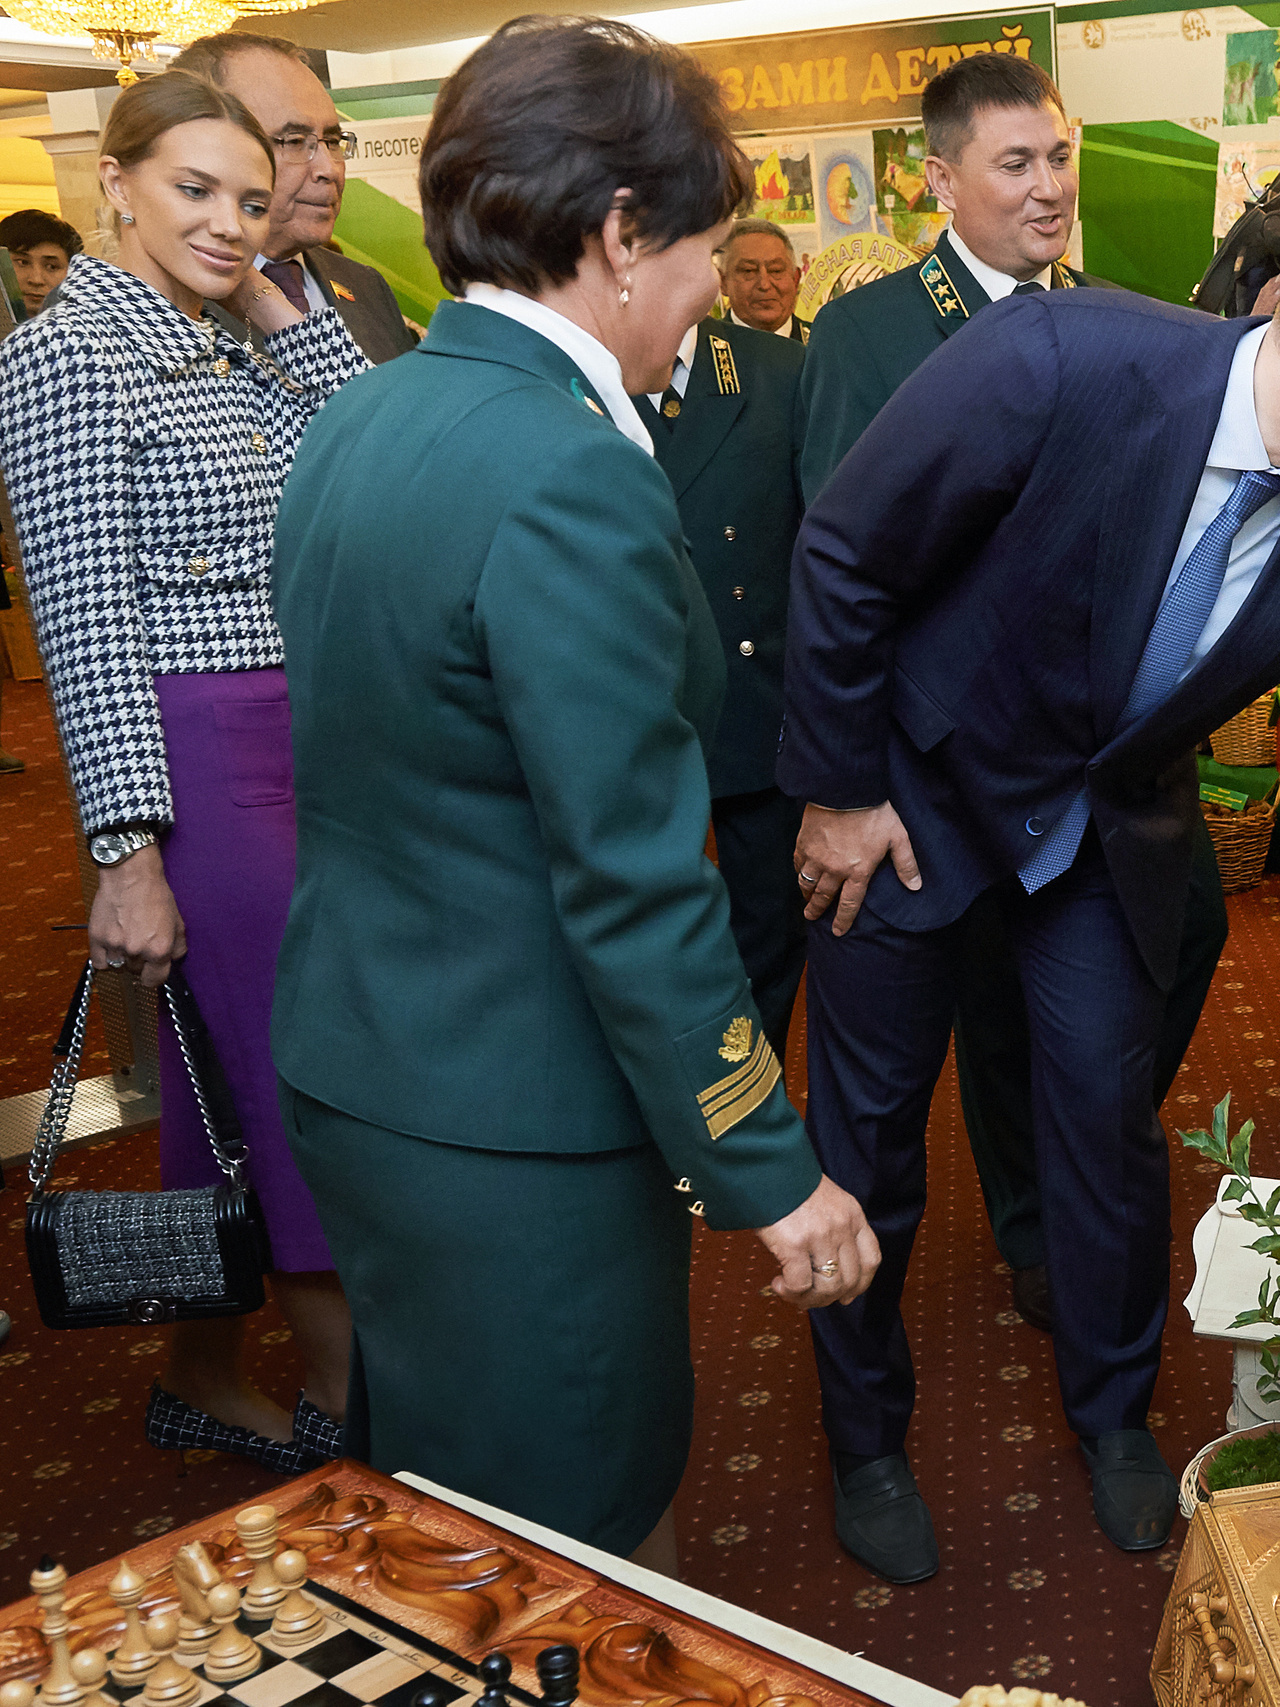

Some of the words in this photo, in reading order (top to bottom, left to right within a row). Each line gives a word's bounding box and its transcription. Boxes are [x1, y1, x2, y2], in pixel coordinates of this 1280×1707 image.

[720, 55, 849, 112] ЗАМИ
[860, 24, 1033, 105] ДЕТЙ
[800, 239, 863, 310] ЛЕСНАЯ
[867, 240, 918, 272] АПТ
[330, 1610, 348, 1623] 2
[367, 1630, 388, 1643] 3
